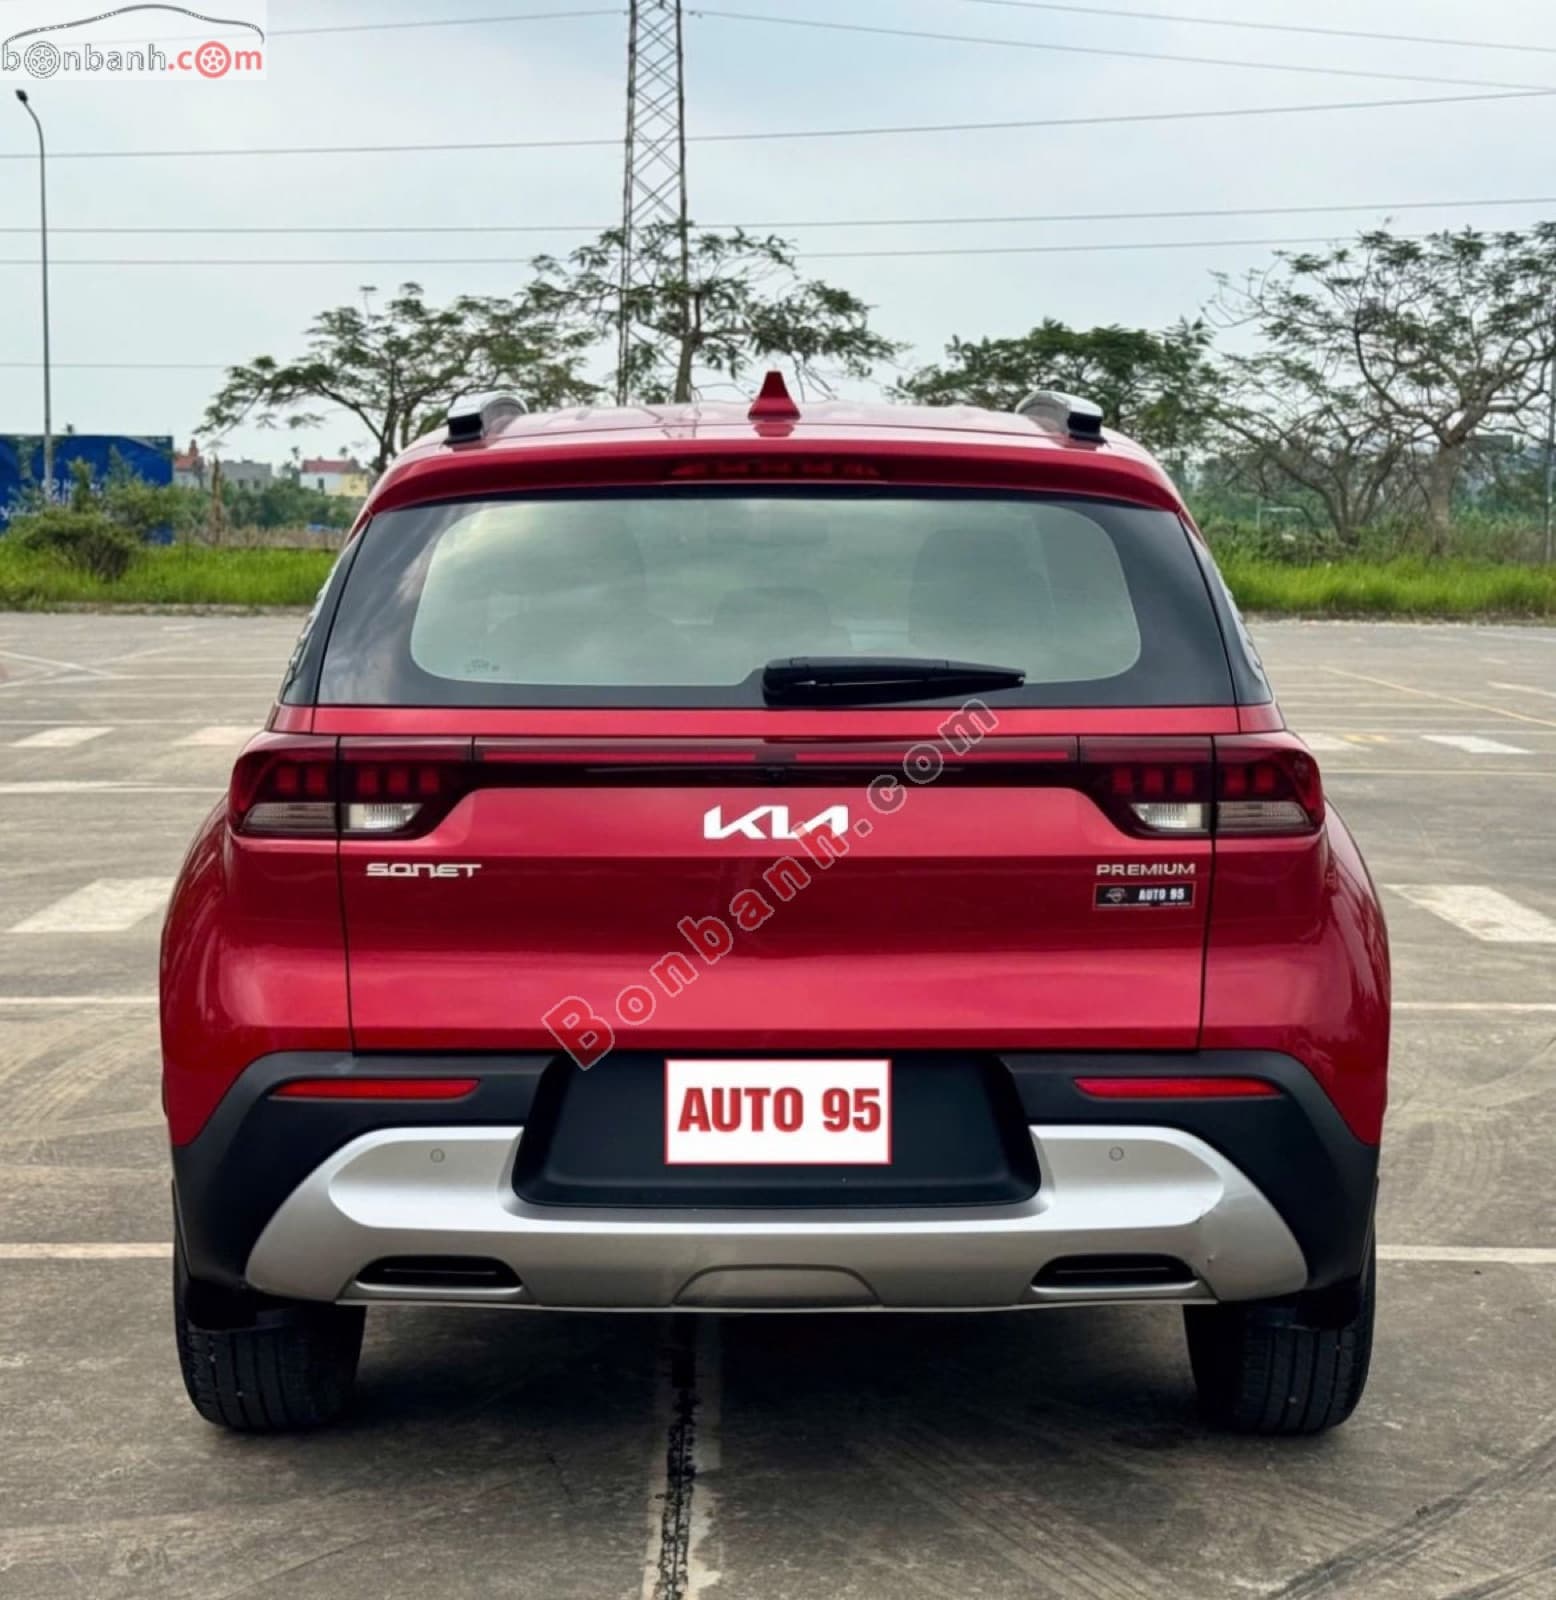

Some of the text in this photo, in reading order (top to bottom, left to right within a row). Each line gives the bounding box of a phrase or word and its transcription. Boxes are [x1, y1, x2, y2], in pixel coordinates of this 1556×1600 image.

[703, 805, 849, 839] KIA
[366, 862, 482, 878] SONET
[1095, 863, 1196, 876] PREMIUM
[1138, 888, 1166, 901] AUTO
[677, 1086, 881, 1133] AUTO 95
